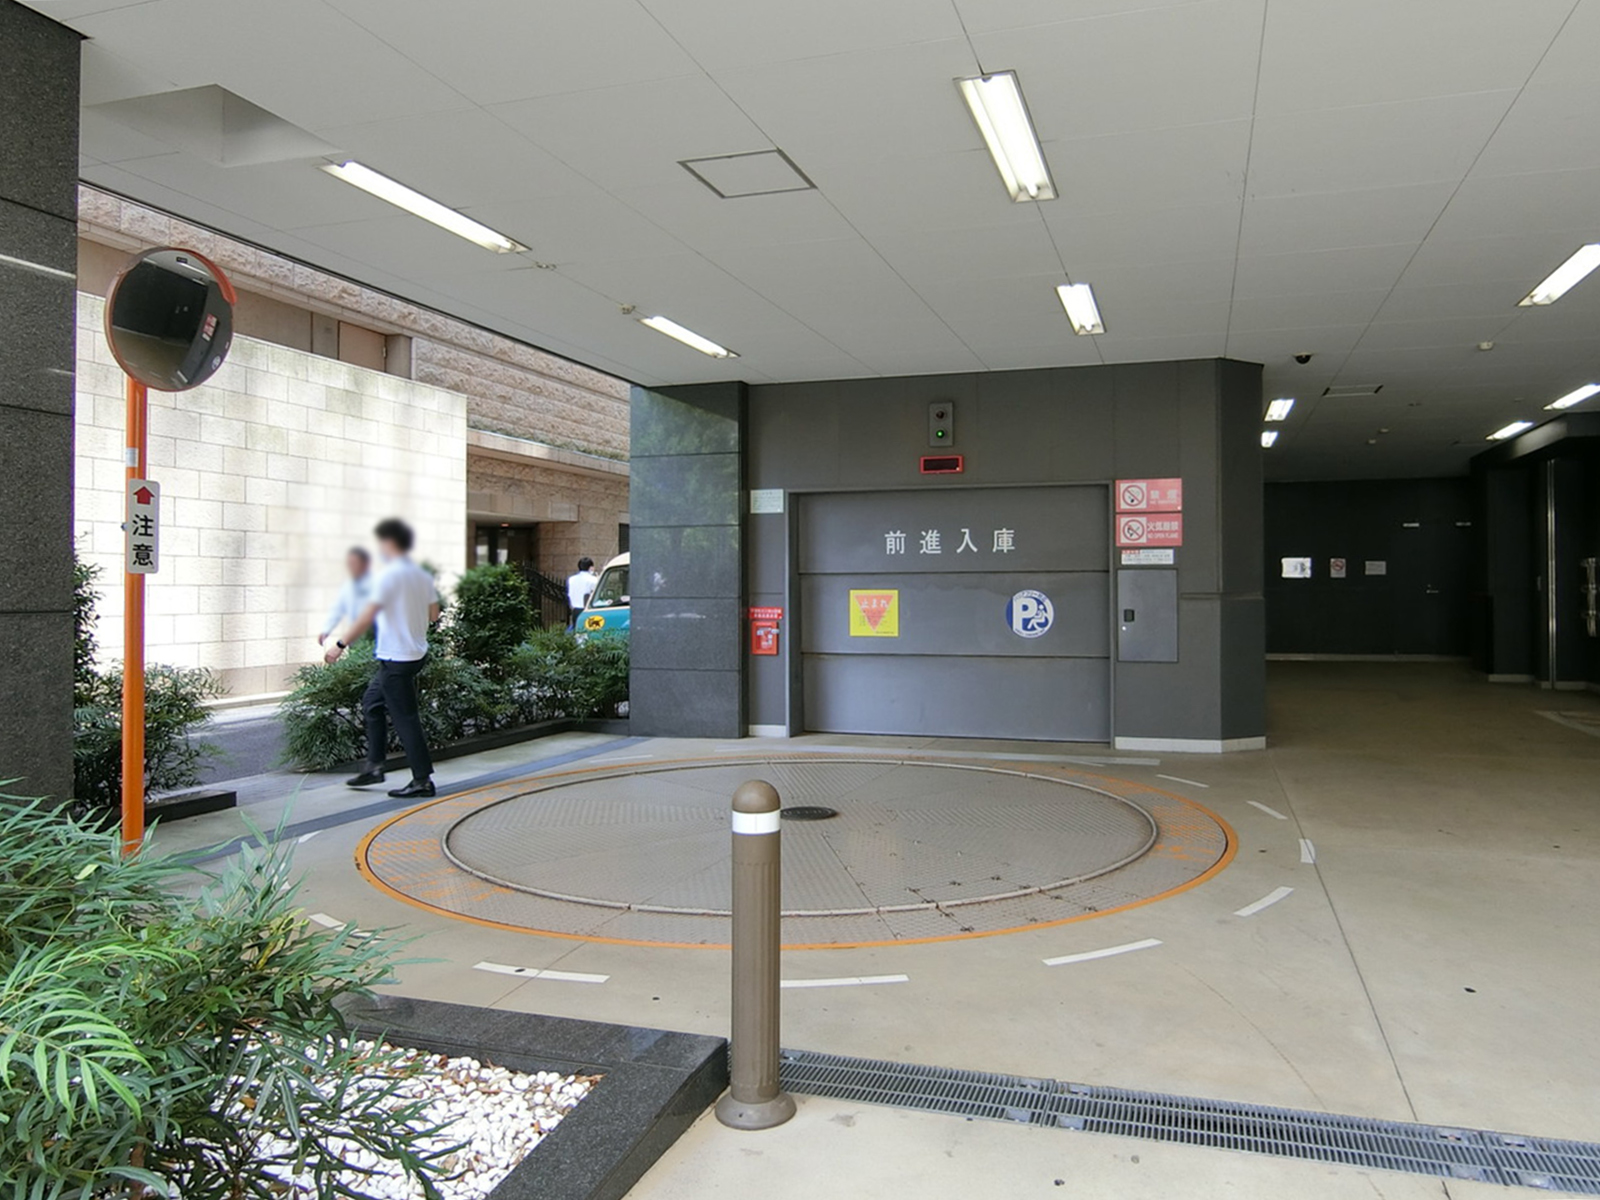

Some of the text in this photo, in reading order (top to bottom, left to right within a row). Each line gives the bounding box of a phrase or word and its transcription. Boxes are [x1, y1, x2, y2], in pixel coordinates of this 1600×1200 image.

[132, 513, 155, 567] 注意
[884, 528, 1016, 555] 前進入庫
